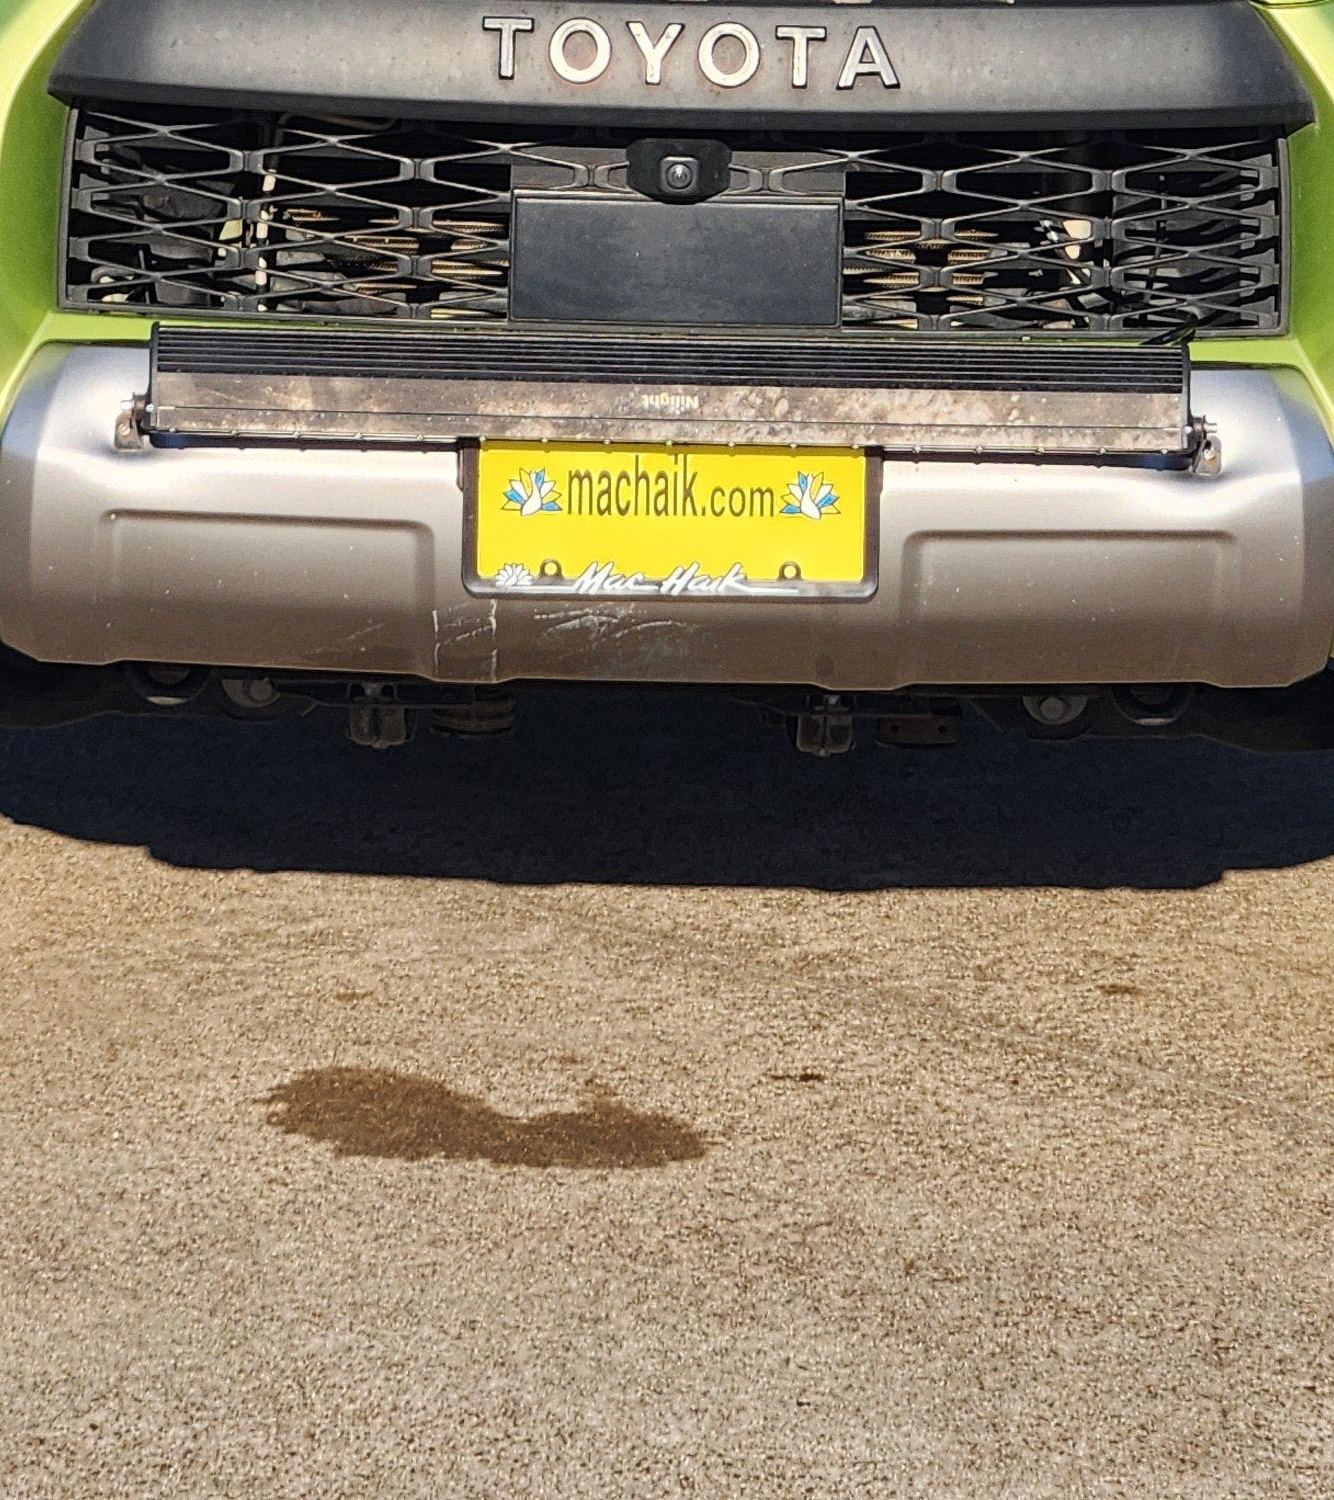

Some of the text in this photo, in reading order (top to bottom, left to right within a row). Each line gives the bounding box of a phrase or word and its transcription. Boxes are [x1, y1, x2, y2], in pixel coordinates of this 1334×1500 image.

[482, 15, 901, 91] TOYOTA
[641, 392, 699, 415] Nilight
[566, 453, 776, 518] machaik.com
[572, 560, 750, 596] Mac Haik
